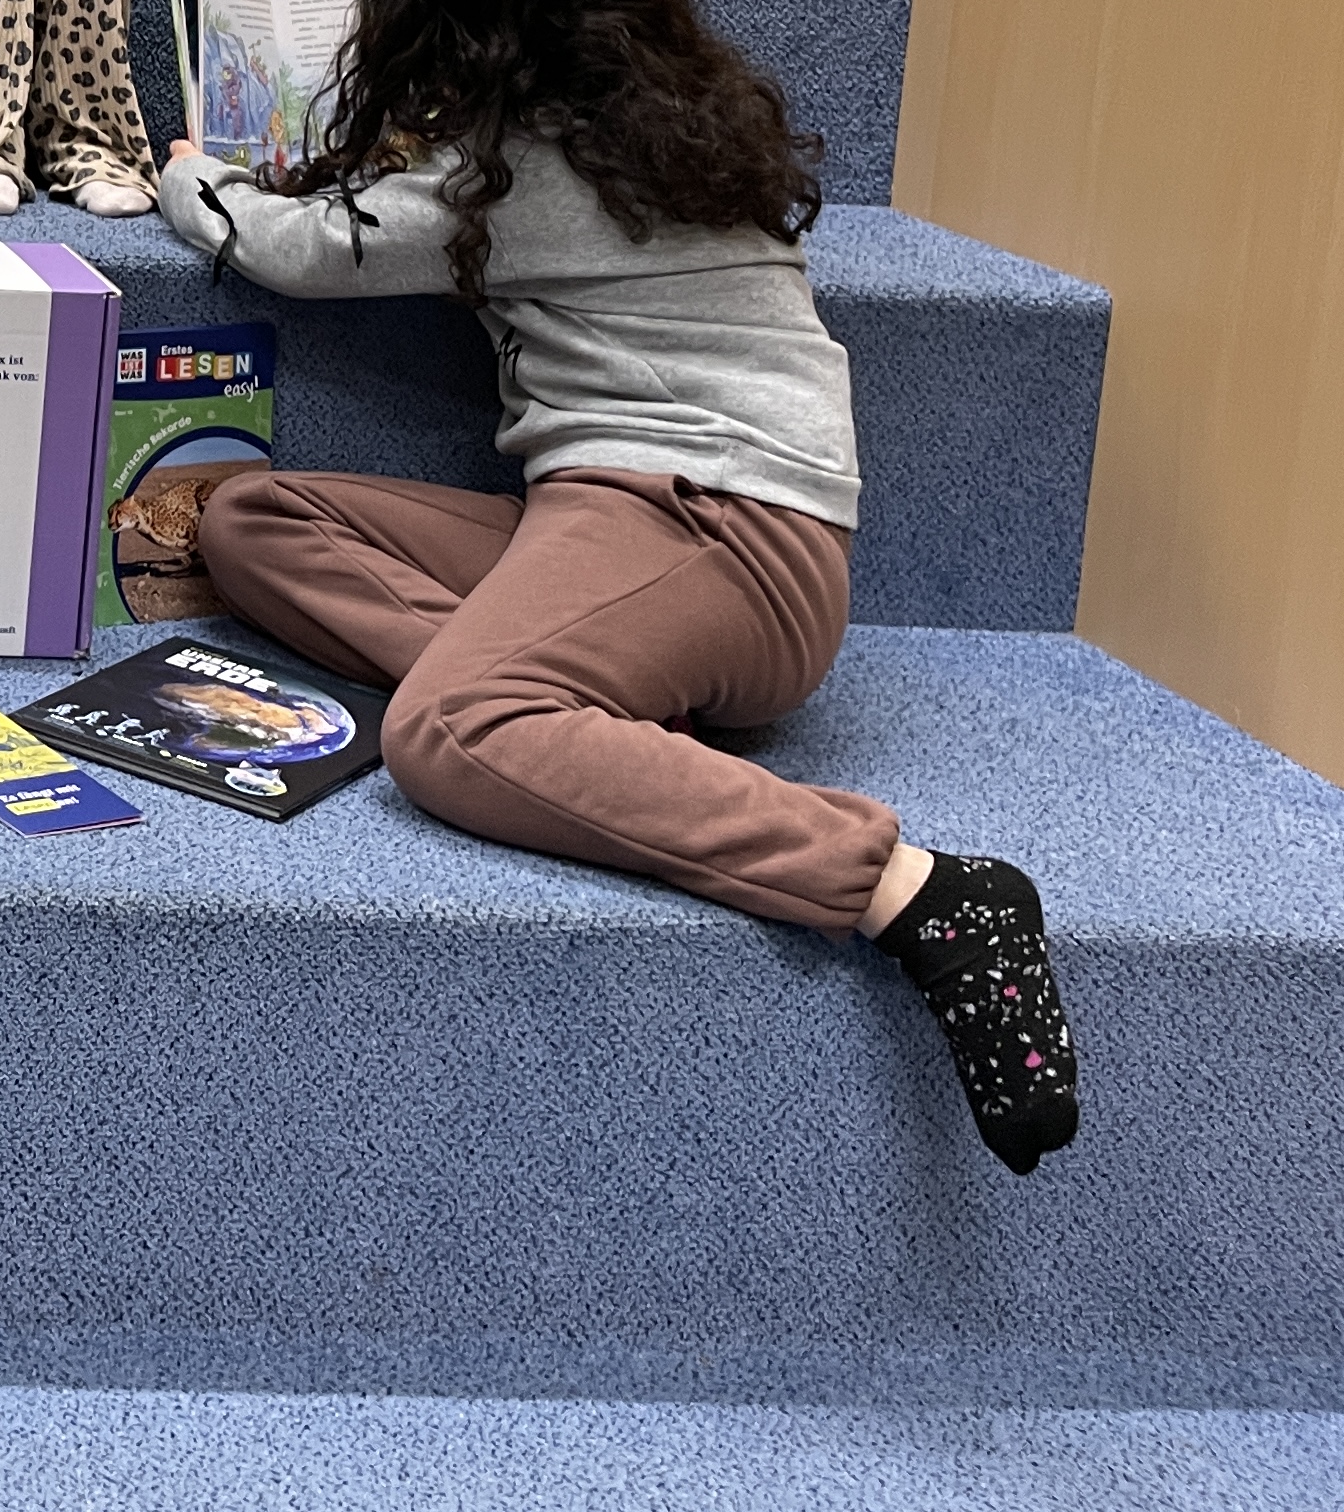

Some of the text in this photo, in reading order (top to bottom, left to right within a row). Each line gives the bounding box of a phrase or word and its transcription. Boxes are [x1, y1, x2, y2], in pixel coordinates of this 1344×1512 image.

[8, 354, 24, 366] ist
[120, 351, 144, 360] WAS
[160, 345, 193, 356] Erstes
[120, 370, 143, 380] WAS
[159, 353, 251, 379] LESEN
[223, 374, 260, 403] easy!
[112, 442, 151, 490] Tierische
[164, 652, 278, 693] ERDE
[180, 648, 265, 678] UNSERE
